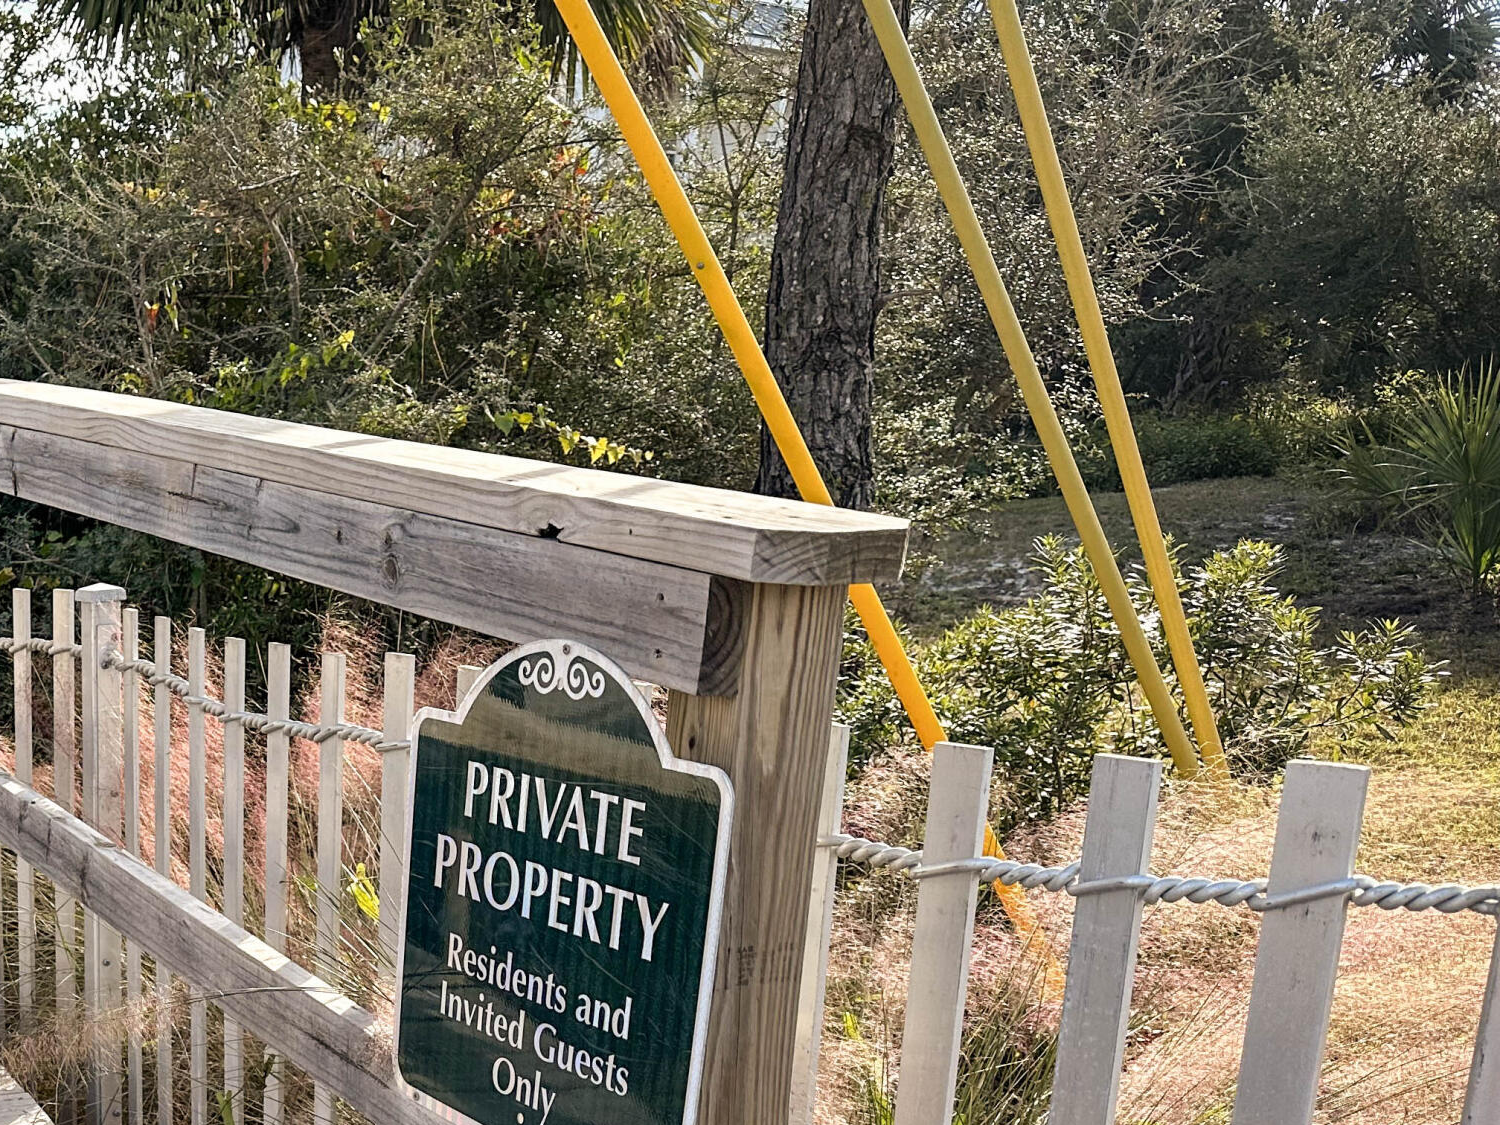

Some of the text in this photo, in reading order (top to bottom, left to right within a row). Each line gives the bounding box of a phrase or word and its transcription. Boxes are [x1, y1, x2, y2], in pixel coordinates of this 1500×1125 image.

[463, 760, 647, 866] PRIVATE
[433, 833, 670, 962] PROPERTY
[440, 980, 629, 1097] Invited Guests
[447, 932, 633, 1040] Residents and
